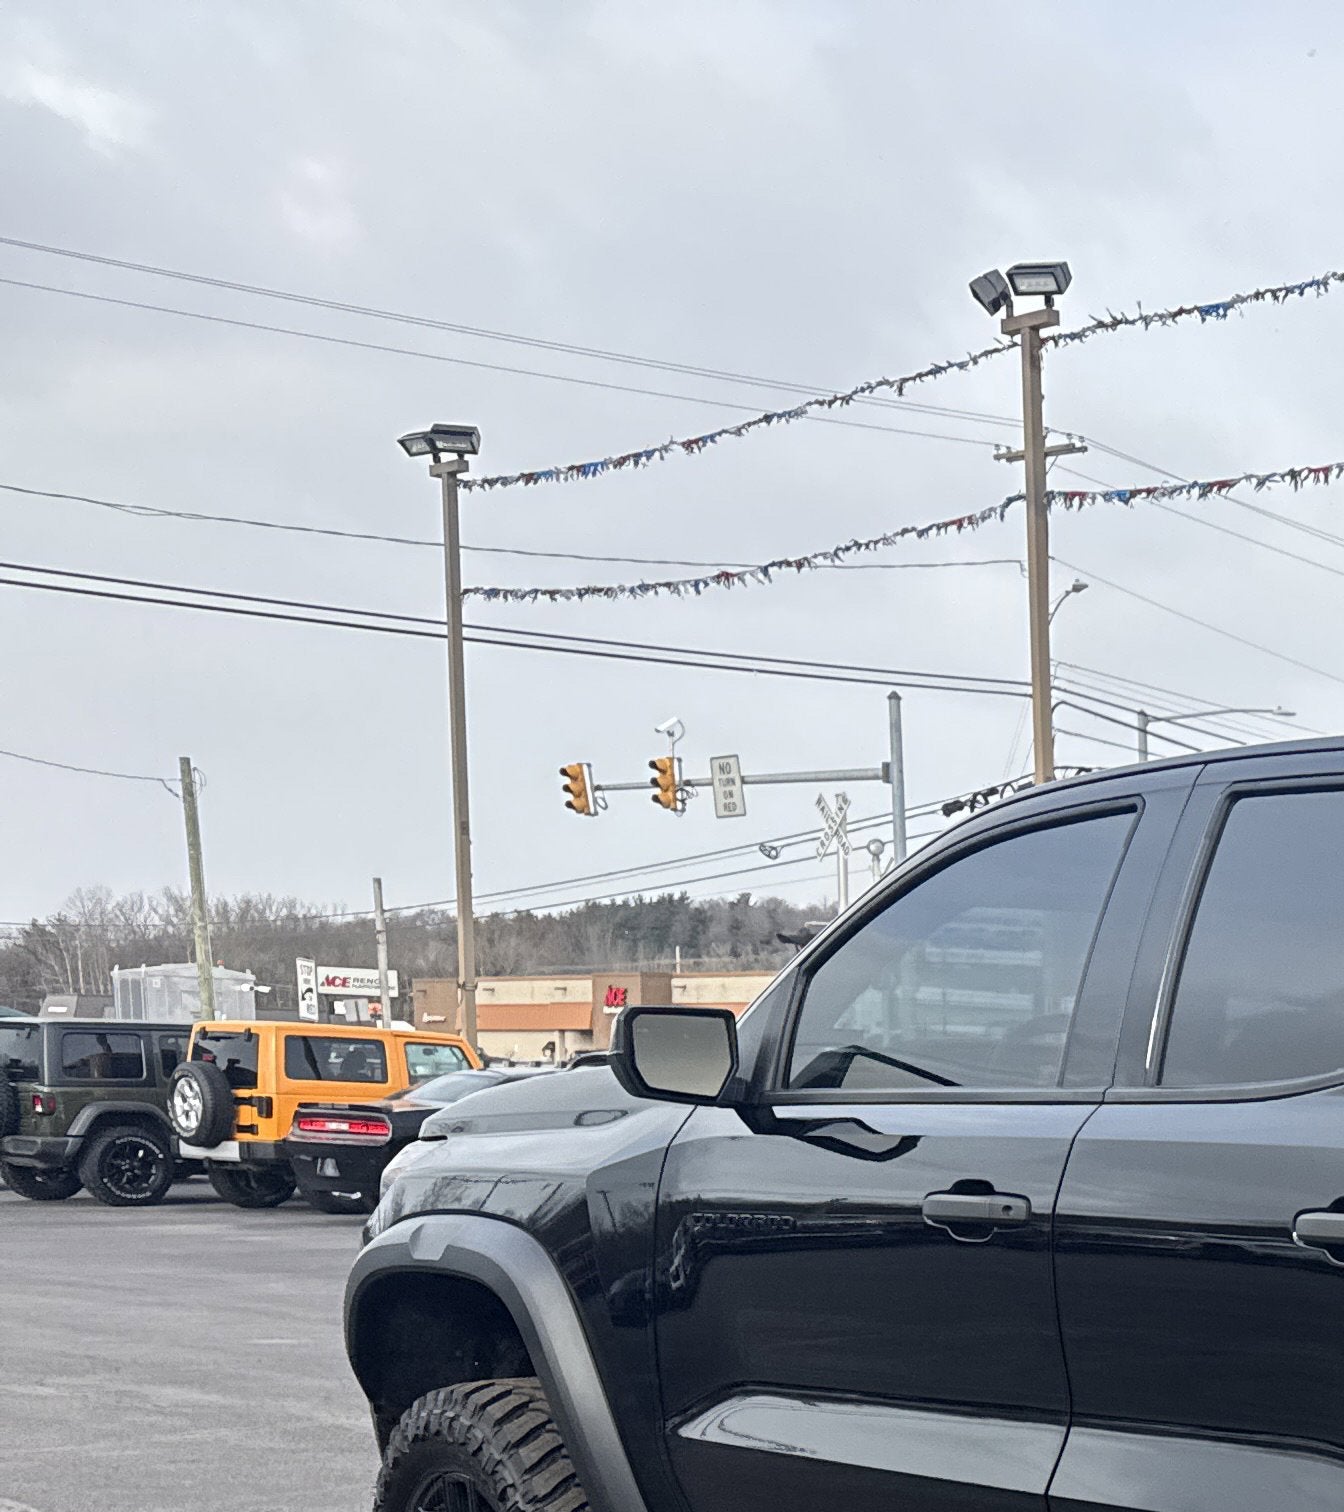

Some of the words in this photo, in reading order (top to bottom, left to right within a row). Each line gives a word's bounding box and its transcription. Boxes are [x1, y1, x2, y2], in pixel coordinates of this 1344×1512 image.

[718, 761, 732, 775] NO
[717, 777, 737, 788] TURN
[722, 789, 734, 800] ON
[723, 801, 738, 813] RED
[320, 974, 351, 989] ACE
[603, 985, 627, 1007] ACE
